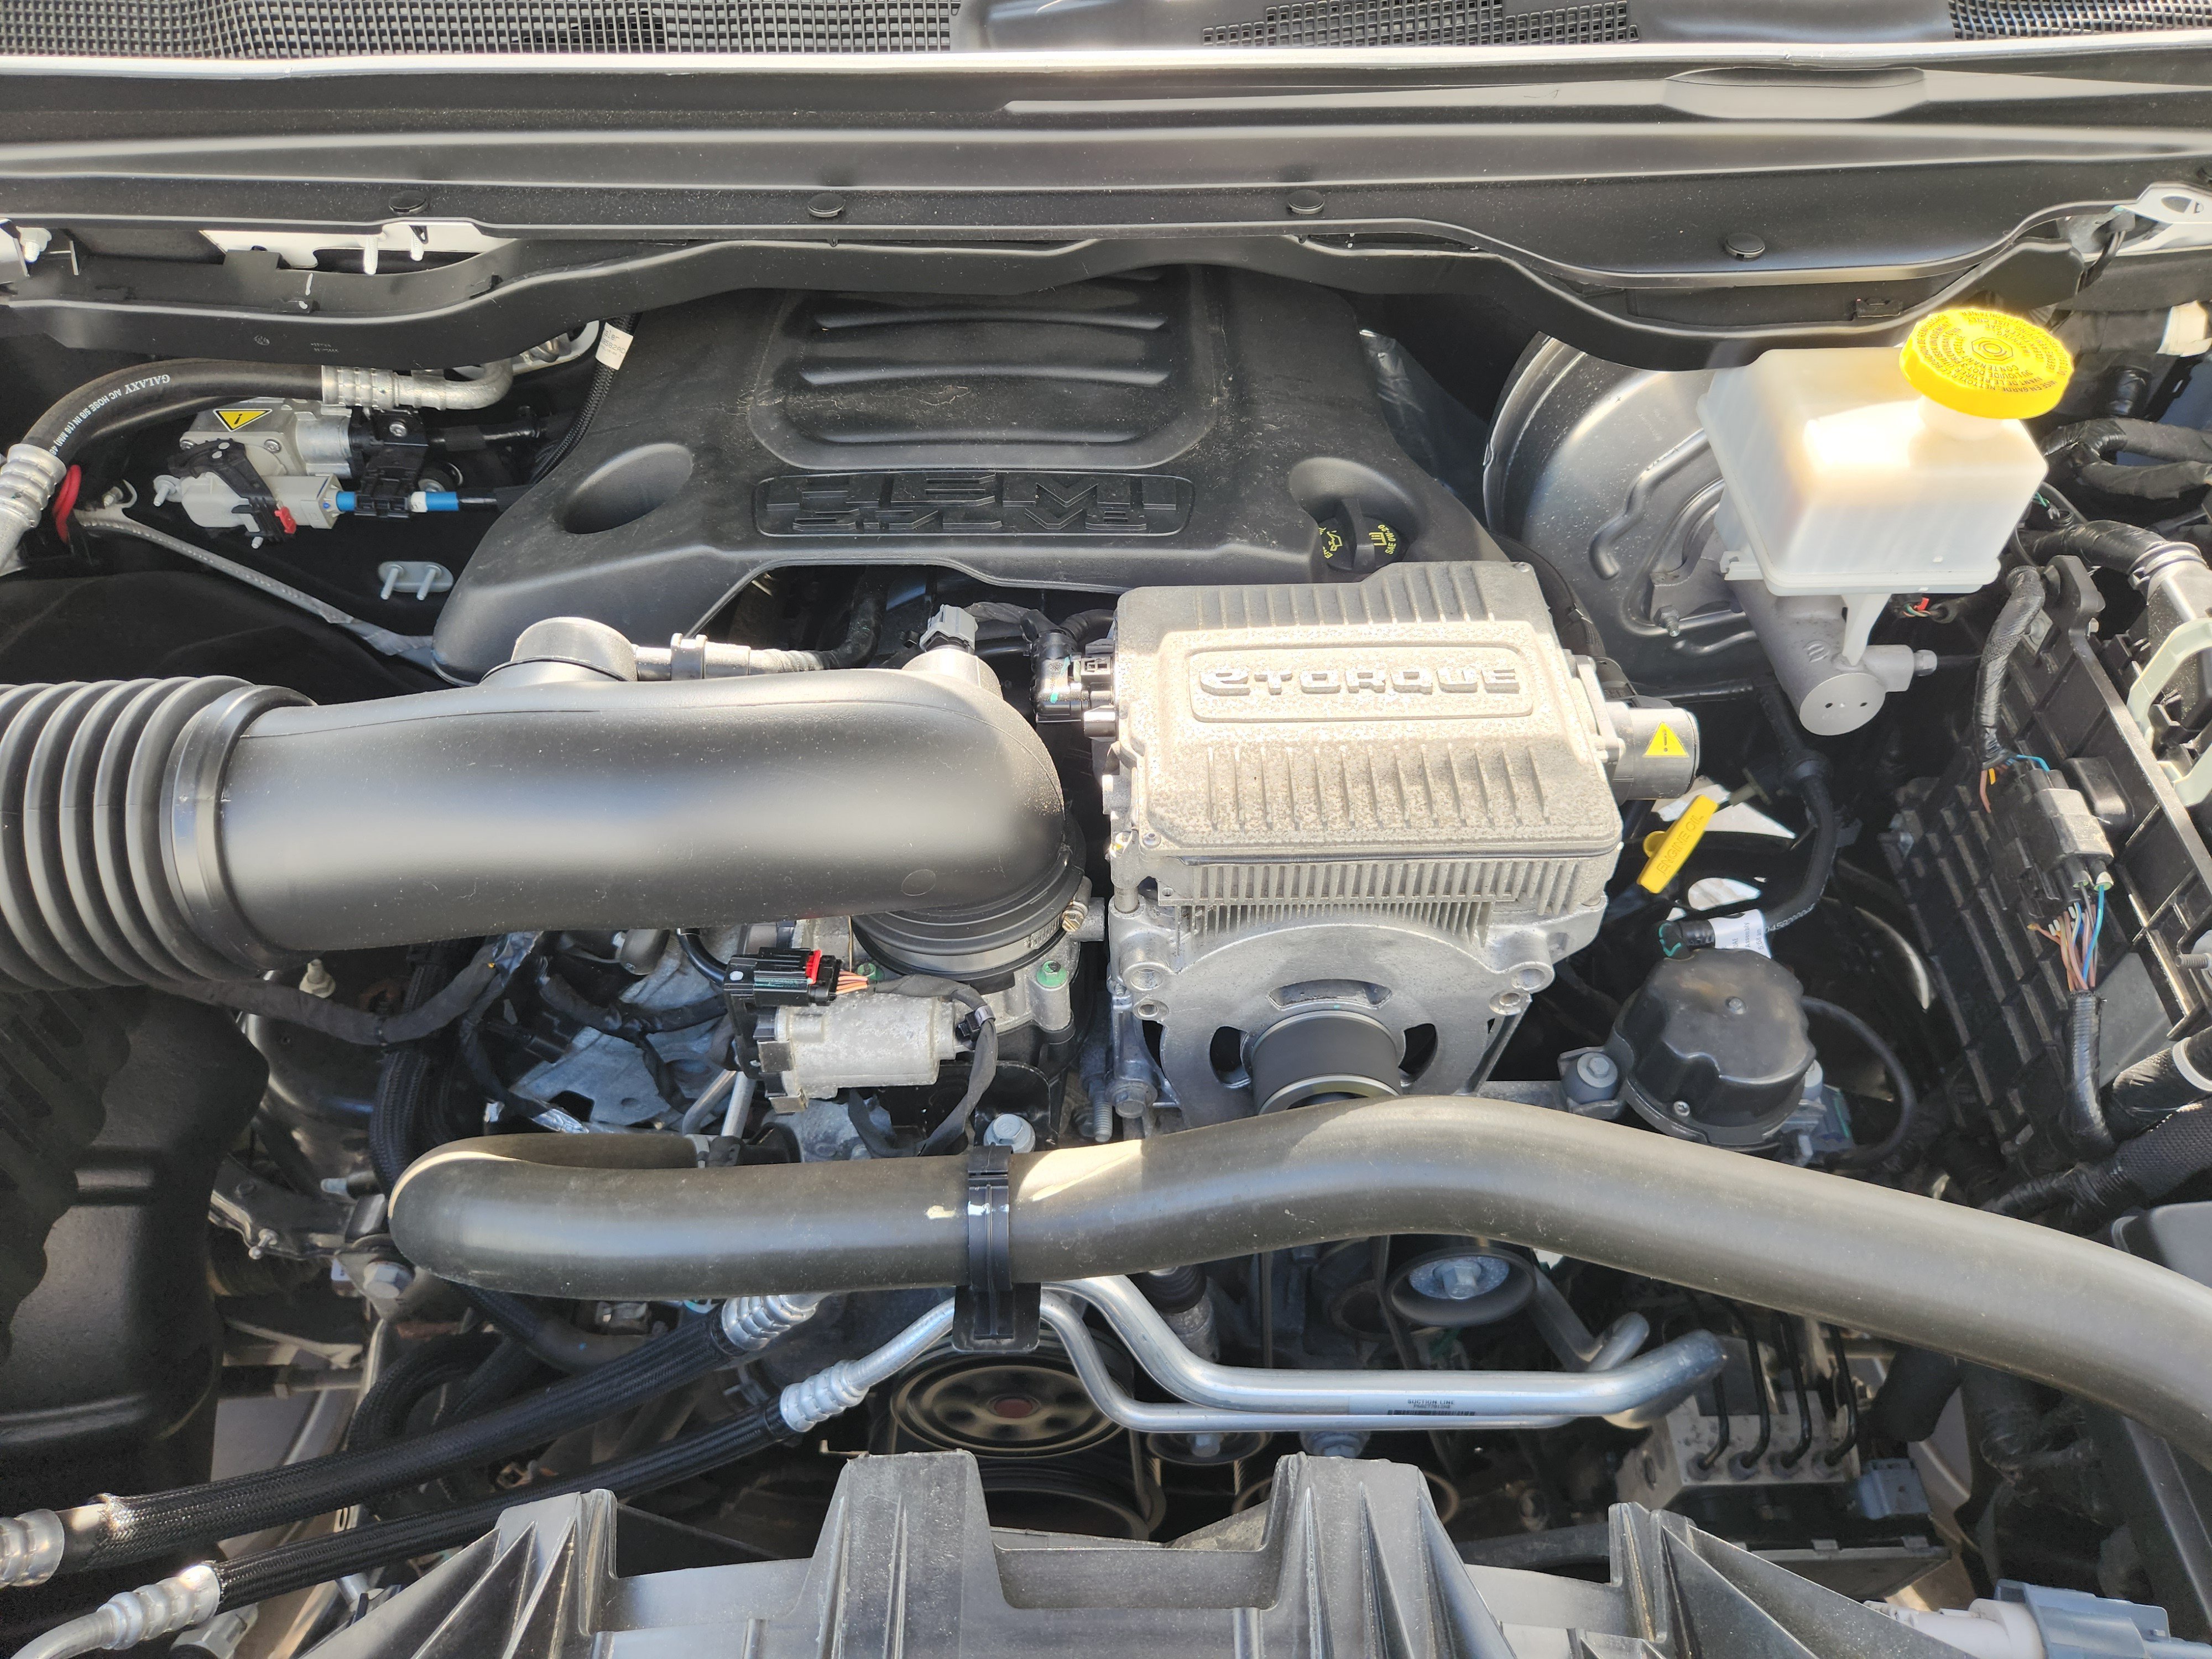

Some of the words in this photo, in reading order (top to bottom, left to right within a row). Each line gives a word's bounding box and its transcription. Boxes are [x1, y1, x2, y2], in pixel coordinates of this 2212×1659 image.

[1961, 356, 2019, 372] CONTENANT
[1967, 366, 1985, 375] DOT
[124, 374, 171, 394] GALAXY
[109, 389, 122, 400] A/C
[88, 394, 110, 411] HOSE
[79, 408, 92, 419] 5/8
[72, 416, 83, 426] IN
[64, 422, 76, 434] (16
[54, 431, 69, 447] MM)
[1385, 542, 1397, 555] SAE
[1656, 831, 1691, 877] ENGINE
[1686, 815, 1704, 832] OIL
